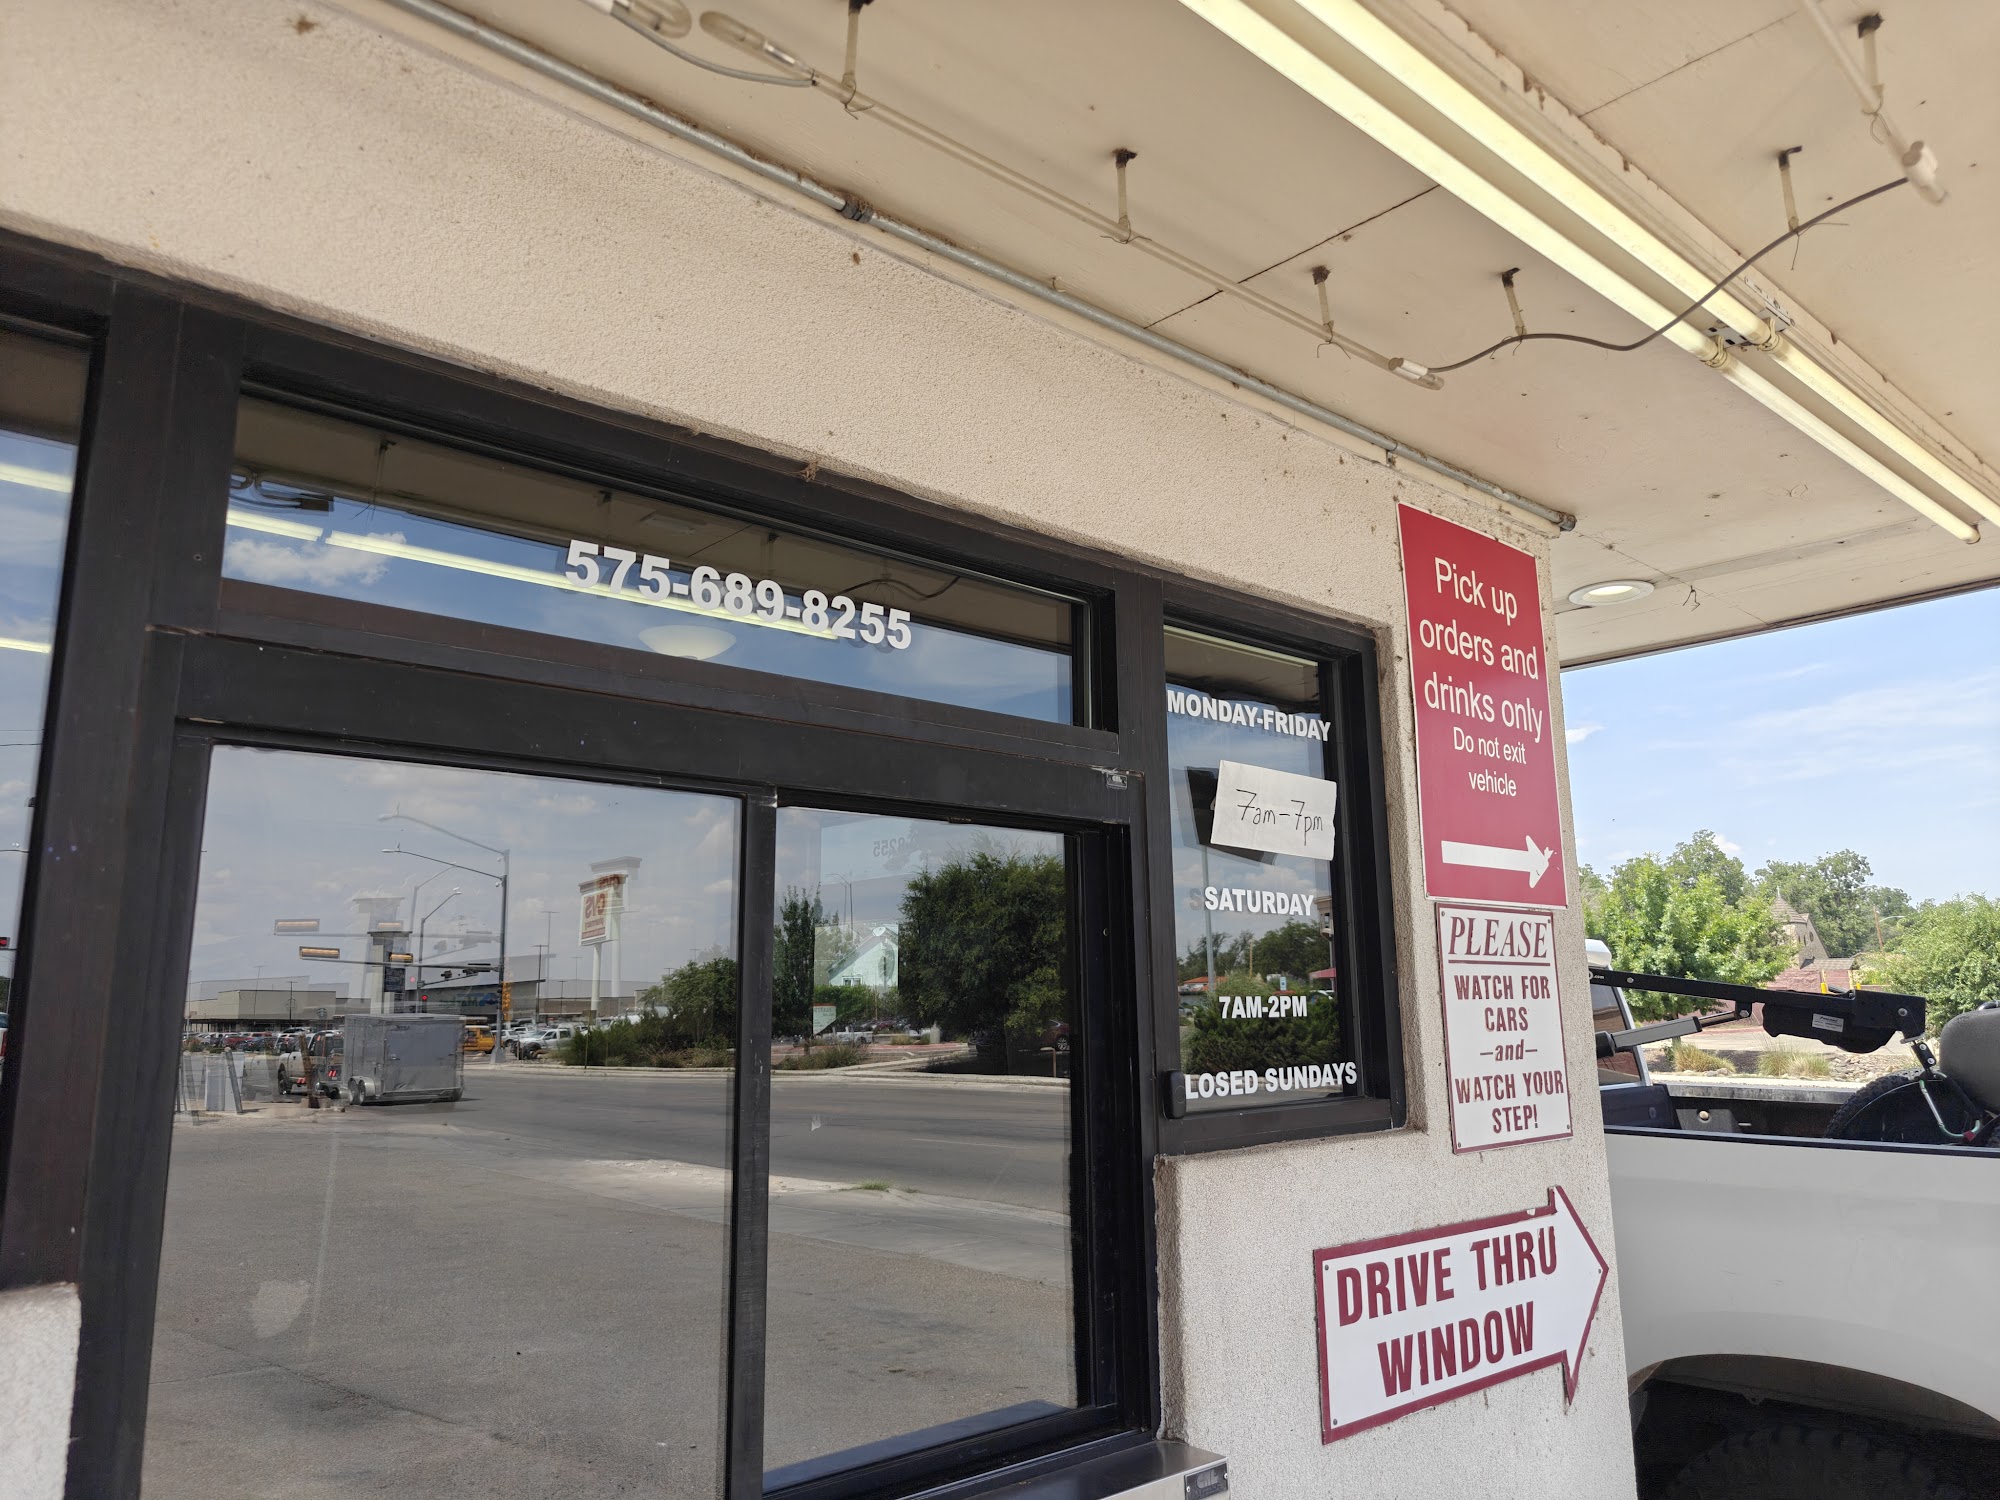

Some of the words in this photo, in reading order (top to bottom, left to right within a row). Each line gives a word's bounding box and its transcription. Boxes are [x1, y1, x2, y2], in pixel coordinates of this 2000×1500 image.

[565, 540, 912, 649] 575-689-8255
[1435, 557, 1486, 608] Pick
[1491, 587, 1518, 626] up
[1419, 619, 1495, 666] orders
[1501, 646, 1539, 680] and
[1167, 690, 1331, 741] MONDAY-FRIDAY
[1424, 671, 1495, 722] drinks
[1501, 697, 1542, 743] only
[1453, 726, 1474, 753] Do
[1478, 737, 1500, 759] not
[1503, 742, 1527, 764] exit
[1468, 769, 1517, 797] vehicle
[1204, 886, 1314, 916] SATURDAY
[1448, 916, 1547, 959] PLEASE
[1454, 975, 1514, 1000] WATCH
[1522, 975, 1550, 999] FOR
[1219, 995, 1308, 1019] 7AM-2PM
[1484, 1006, 1529, 1032] CARS
[1185, 1070, 1258, 1100] LOSED
[1265, 1062, 1357, 1092] SUNDAYS
[1455, 1073, 1516, 1104] WATCH
[1522, 1070, 1564, 1097] YOUR
[1492, 1104, 1538, 1133] STEP!
[1337, 1247, 1454, 1327] DRIVE
[1470, 1226, 1557, 1291] THRU
[1377, 1301, 1534, 1398] WINDOW
